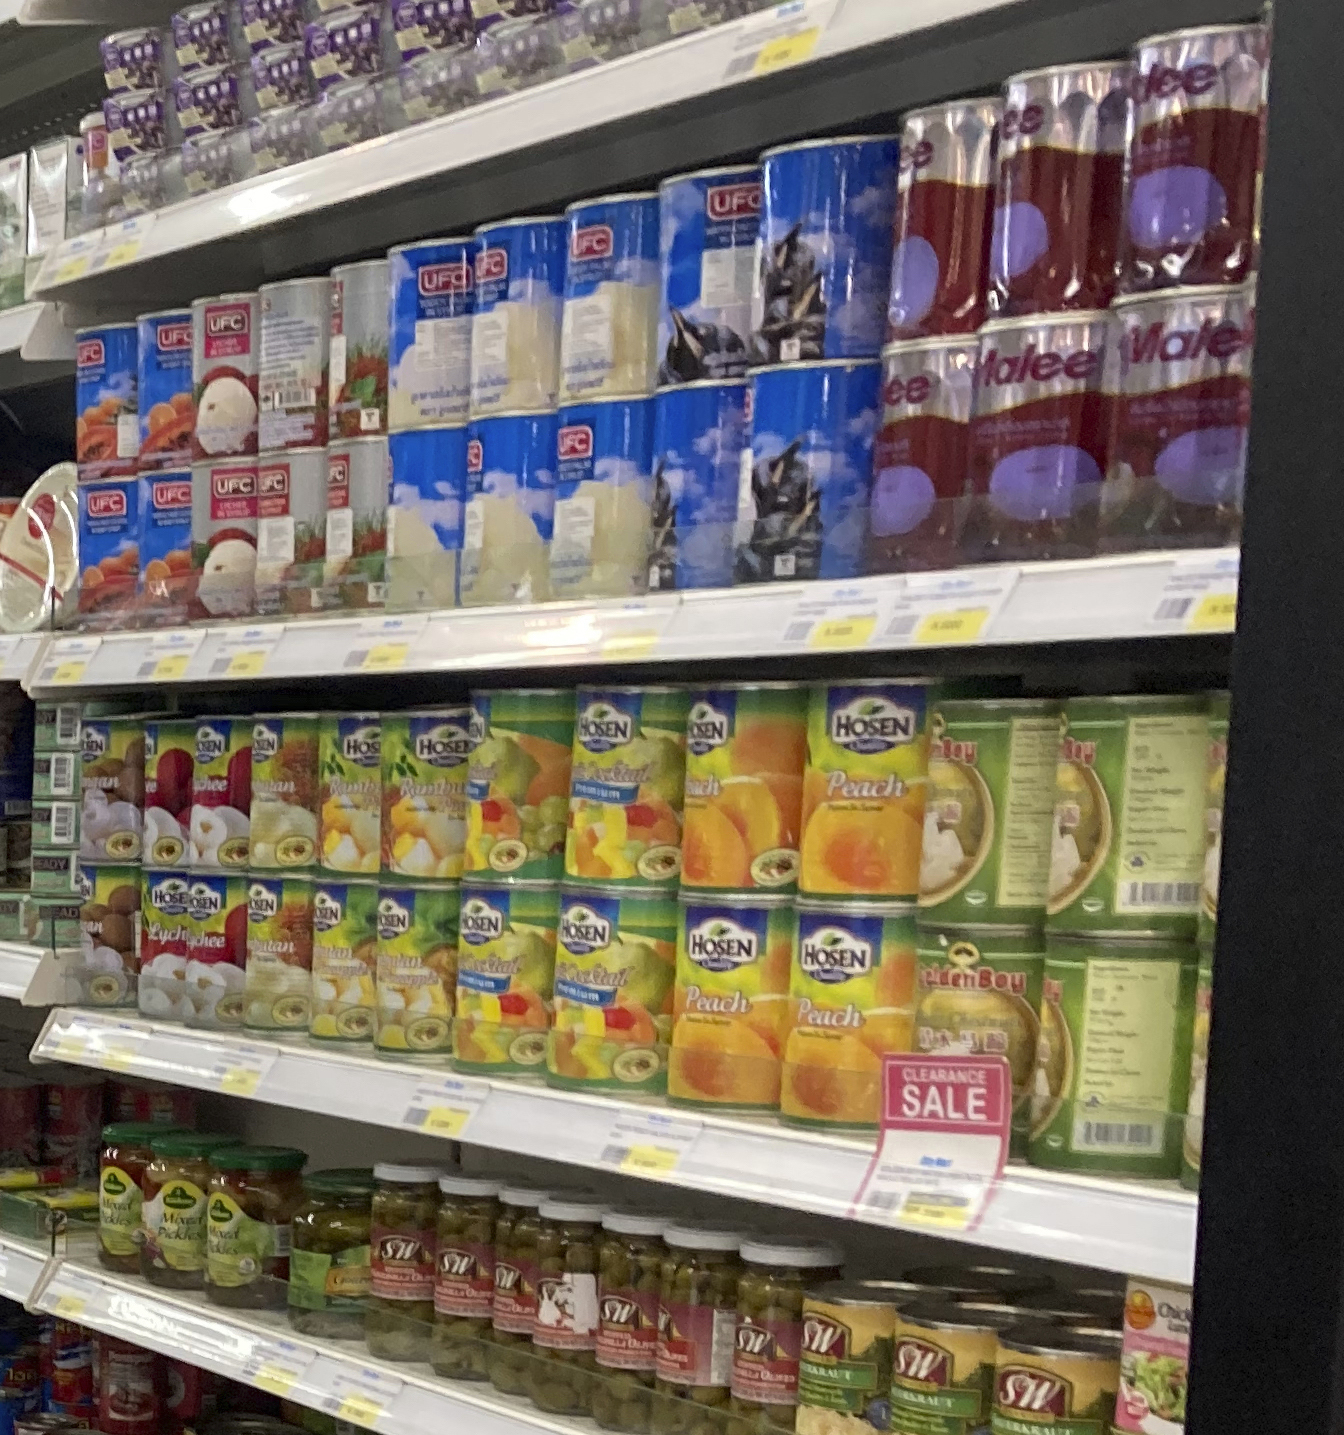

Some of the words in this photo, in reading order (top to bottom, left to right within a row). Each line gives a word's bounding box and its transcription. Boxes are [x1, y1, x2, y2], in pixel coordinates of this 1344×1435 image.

[210, 315, 244, 332] UFC
[216, 479, 254, 495] UFC
[90, 496, 123, 513] UFC
[689, 719, 724, 740] OSEN
[834, 714, 911, 738] HOSEN
[197, 738, 223, 753] OSEN
[346, 741, 380, 756] HOS
[193, 776, 228, 793] ychee
[826, 769, 907, 799] Peach
[153, 890, 188, 906] HOSE
[190, 895, 219, 911] OSEN
[250, 895, 275, 911] OSEN
[314, 904, 339, 921] OSEN
[149, 926, 187, 944] Lych
[187, 930, 226, 949] ychee
[691, 933, 753, 959] HOSEN
[803, 943, 867, 970] HOSEN
[685, 985, 750, 1015] Peach
[797, 997, 864, 1029] Peach
[901, 1067, 988, 1085] CLEARANCE
[901, 1083, 989, 1122] SALE
[162, 1212, 204, 1227] Mixed
[157, 1226, 206, 1242] Pickles
